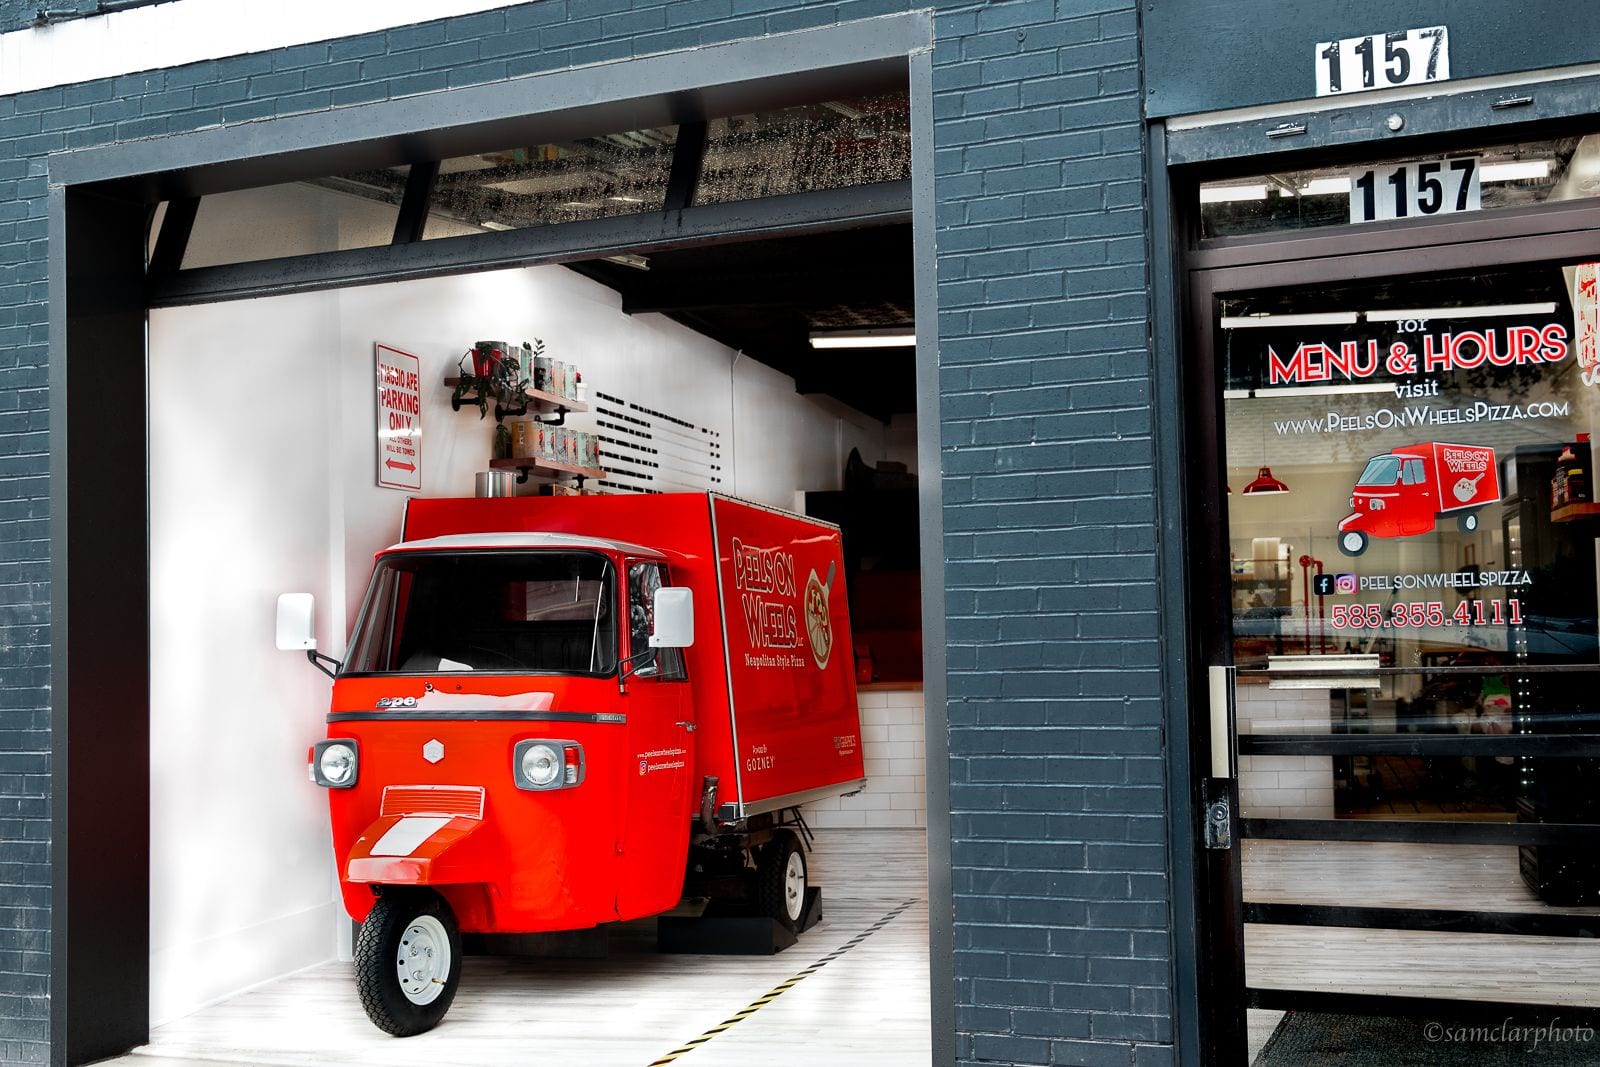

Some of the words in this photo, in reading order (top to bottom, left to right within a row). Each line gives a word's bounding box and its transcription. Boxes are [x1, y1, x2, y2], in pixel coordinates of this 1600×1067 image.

[1321, 28, 1446, 92] 1157
[1356, 158, 1476, 221] 1157
[1396, 317, 1429, 334] for
[1269, 339, 1379, 385] MENU
[1386, 342, 1418, 375] &
[1424, 322, 1568, 373] HOURS
[406, 371, 418, 392] APE
[1394, 379, 1439, 399] visit
[381, 388, 419, 416] PARKING
[1446, 459, 1487, 473] WHEELS
[1359, 570, 1533, 591] PEELSONWHEELSPIZZA
[741, 592, 798, 649] WHEELS
[1330, 598, 1524, 630] 585.355.4111
[744, 653, 776, 670] Neapolitan
[776, 654, 790, 670] Style
[790, 654, 805, 668] Pizza
[746, 755, 774, 772] GOZNEY
